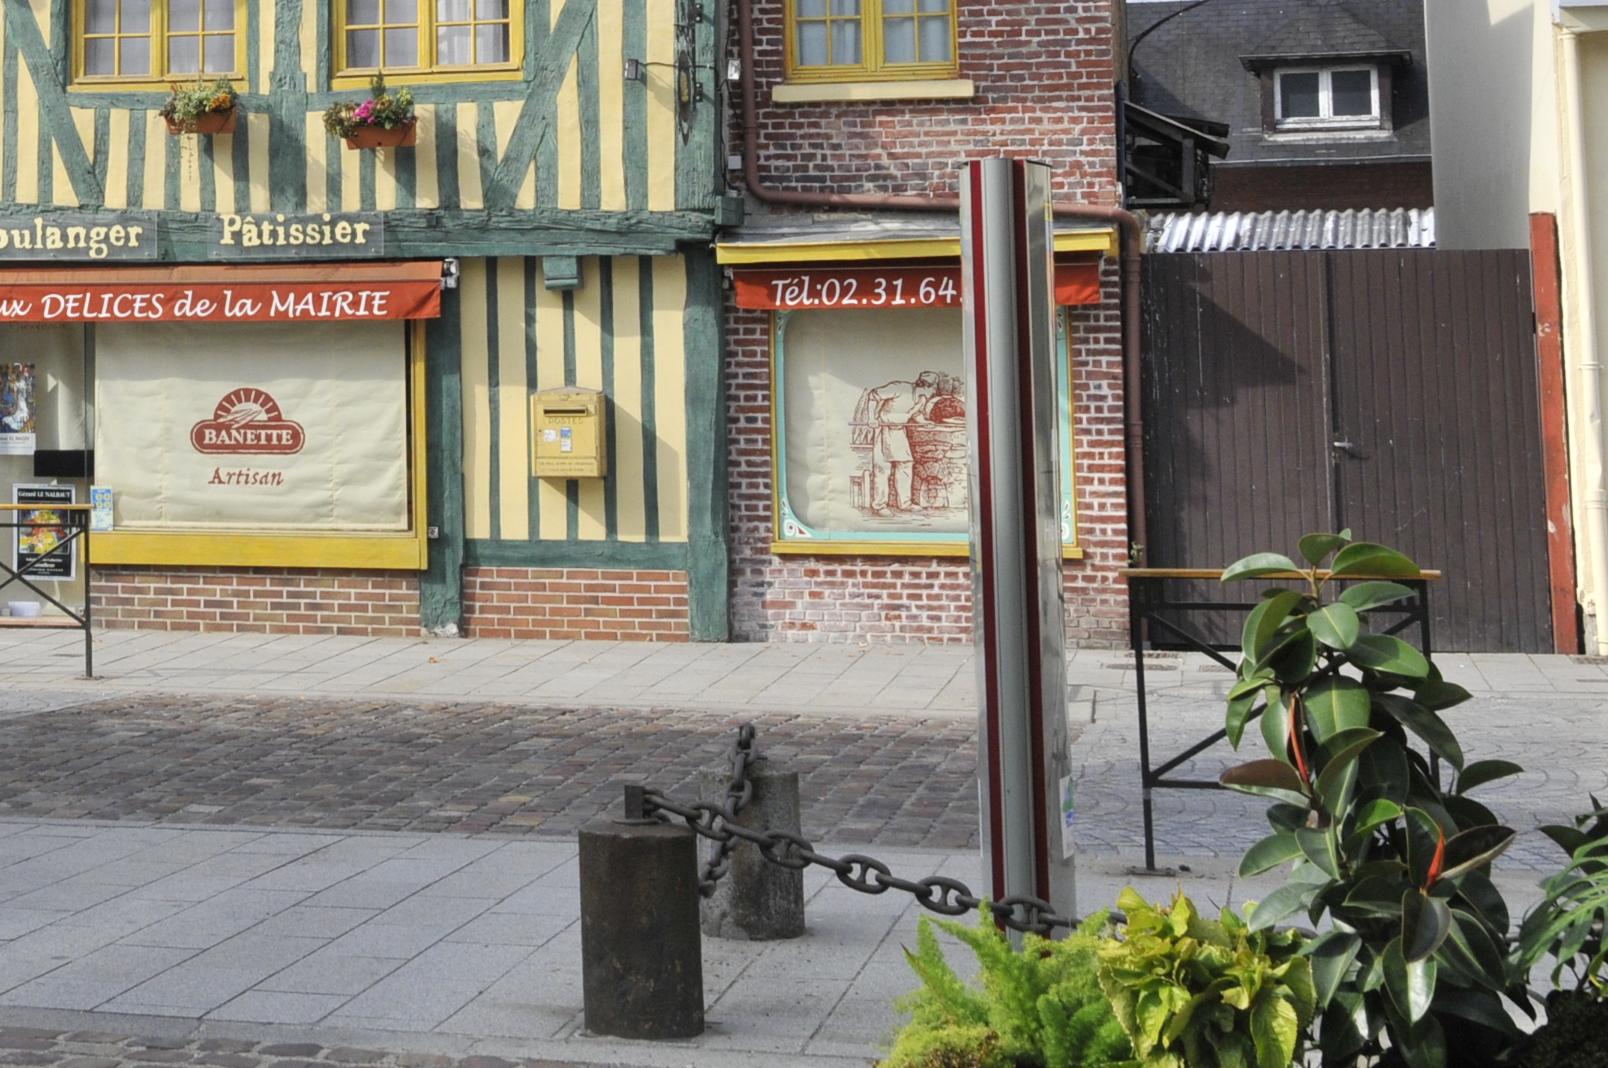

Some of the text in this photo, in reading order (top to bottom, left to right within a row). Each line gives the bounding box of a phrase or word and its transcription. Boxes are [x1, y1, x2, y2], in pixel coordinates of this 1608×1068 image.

[219, 213, 370, 247] Pâtissier
[41, 291, 164, 319] DELICES
[173, 290, 217, 317] de
[223, 289, 262, 317] la
[269, 290, 391, 318] MAIRIE
[203, 428, 294, 445] BANETTE
[208, 466, 284, 486] Artisan
